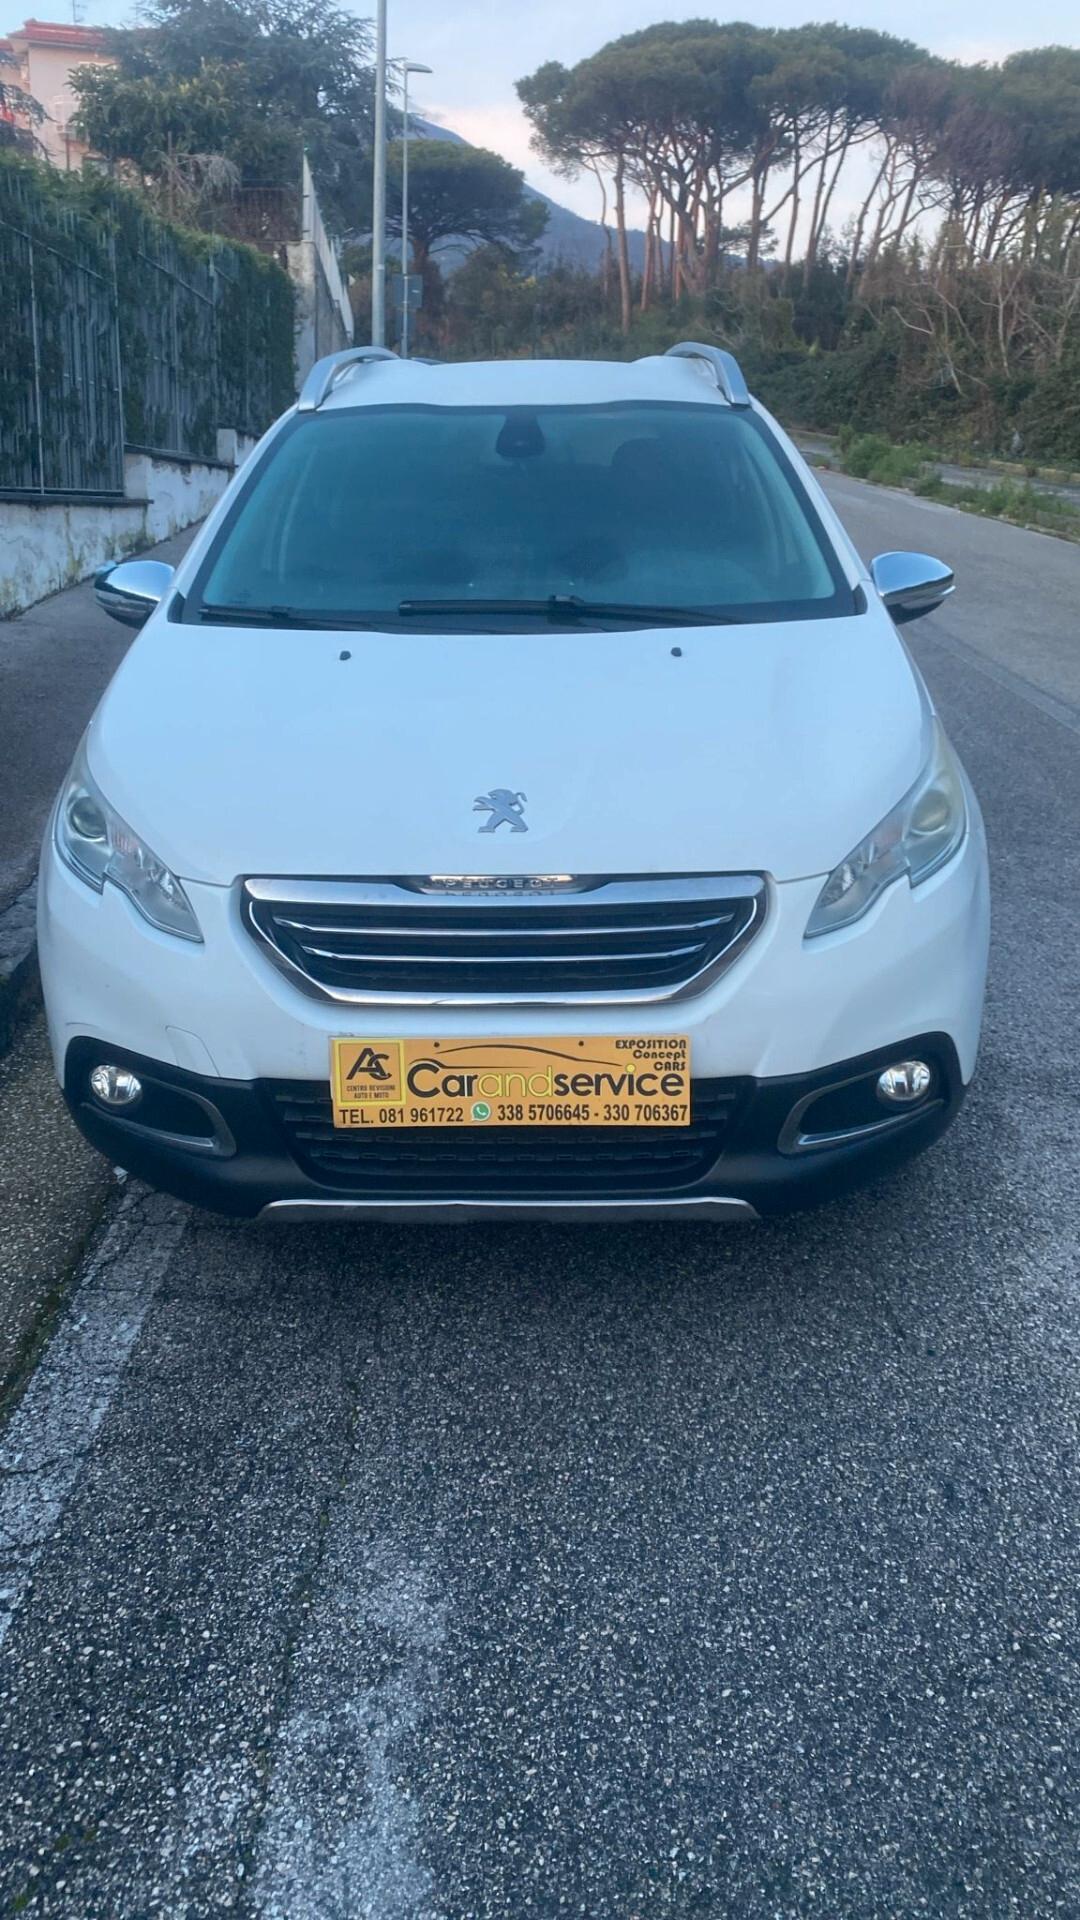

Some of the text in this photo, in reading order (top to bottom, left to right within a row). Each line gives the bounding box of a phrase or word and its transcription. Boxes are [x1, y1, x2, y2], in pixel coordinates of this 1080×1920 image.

[615, 1040, 687, 1049] EXPOSITION
[633, 1049, 686, 1060] Concept
[653, 1061, 686, 1071] CARS
[407, 1063, 684, 1098] Carandservice
[339, 1109, 374, 1124] TEL.
[379, 1108, 404, 1123] 081
[410, 1107, 464, 1123] 961722
[497, 1104, 524, 1121] 338
[528, 1104, 590, 1121] 5706645
[603, 1104, 630, 1121] 330
[634, 1104, 688, 1121] 706367
